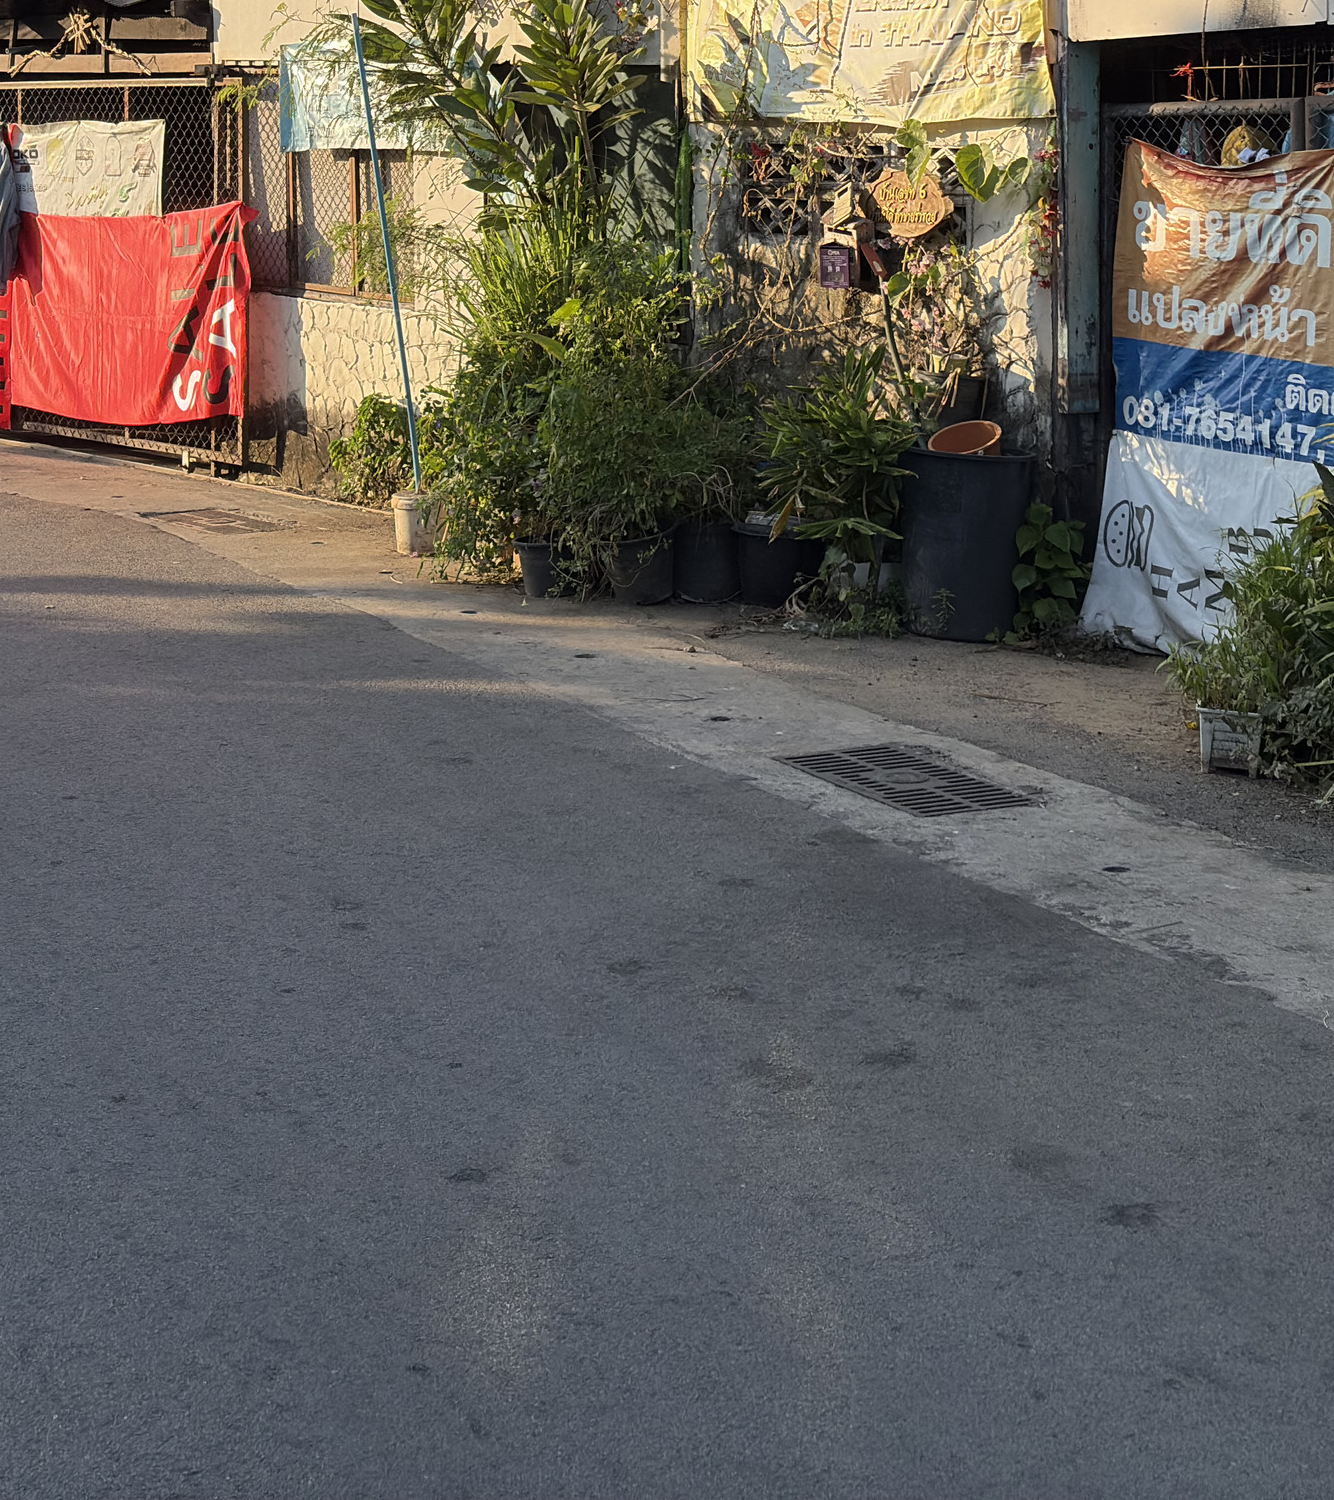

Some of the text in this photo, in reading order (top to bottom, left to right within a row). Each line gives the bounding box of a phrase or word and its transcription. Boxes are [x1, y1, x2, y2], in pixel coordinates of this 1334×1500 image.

[919, 182, 928, 200] 6
[1128, 284, 1316, 347] แปลงหน้า
